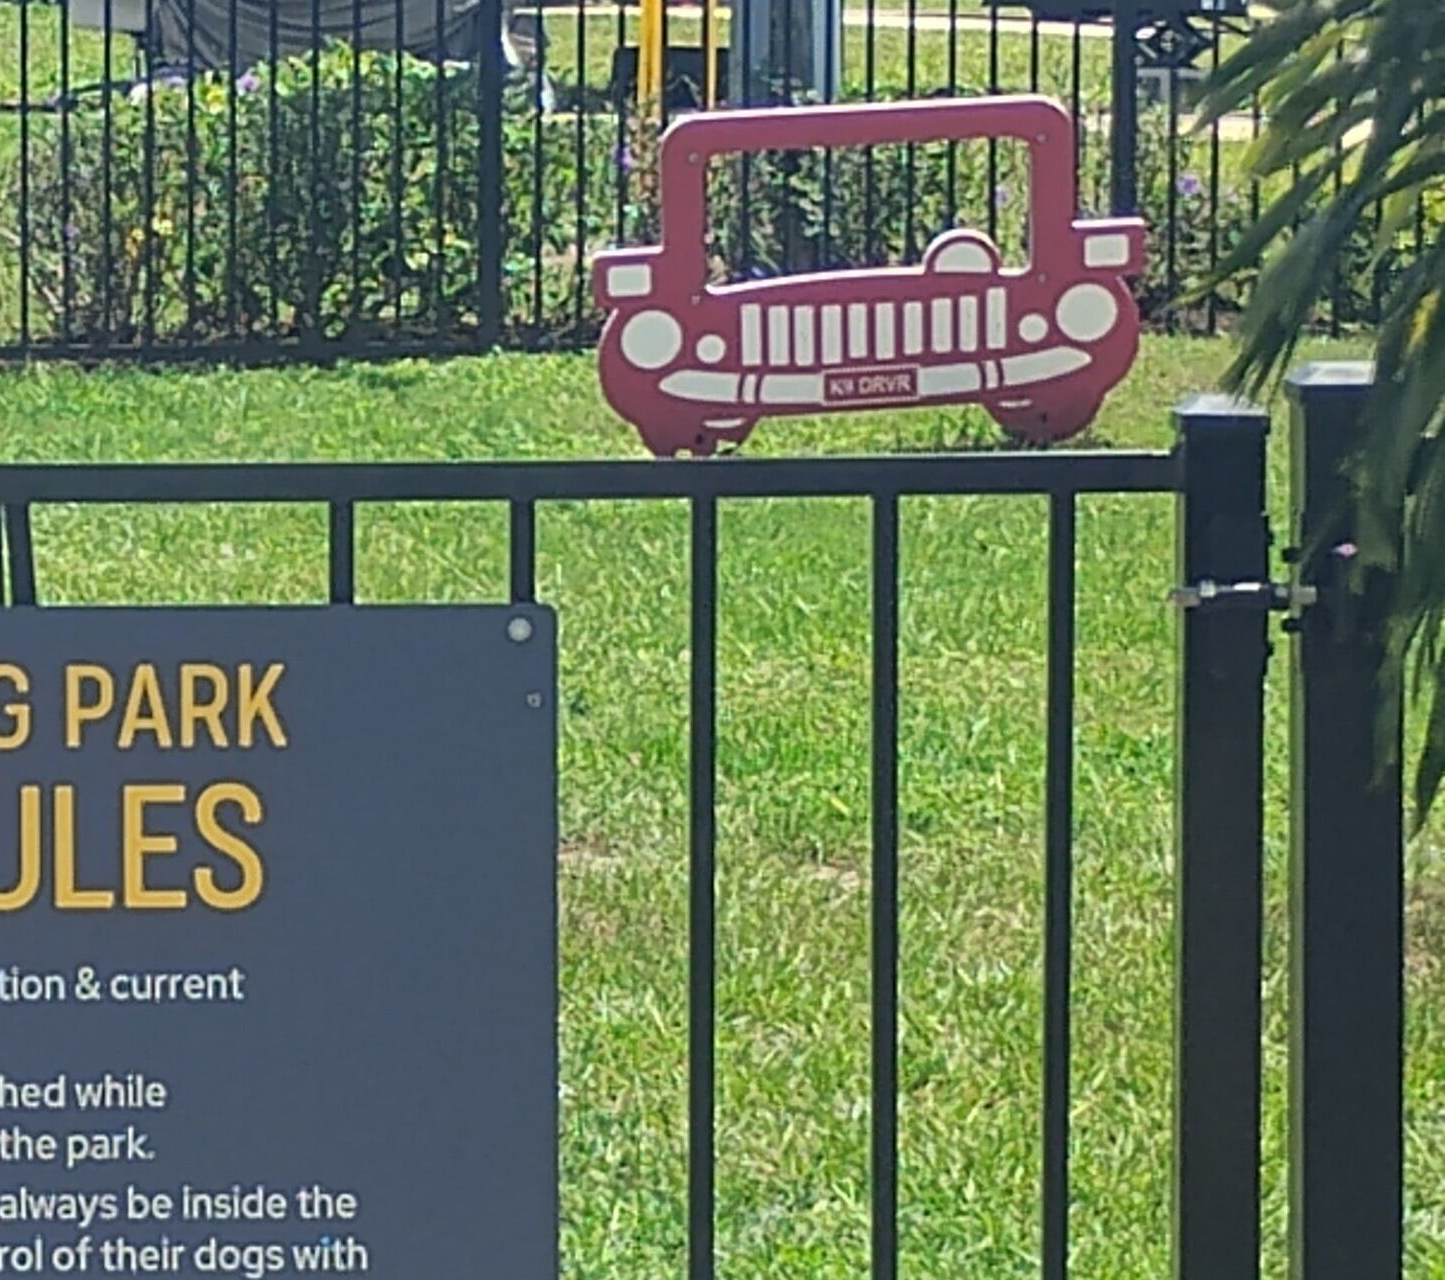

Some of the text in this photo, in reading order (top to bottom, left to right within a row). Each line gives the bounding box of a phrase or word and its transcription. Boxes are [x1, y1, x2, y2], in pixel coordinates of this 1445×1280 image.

[858, 374, 911, 395] DRVR
[66, 663, 287, 748] PARK
[74, 966, 101, 1001] &
[110, 968, 245, 1001] current
[74, 1074, 167, 1109] while
[67, 1125, 155, 1169] park.
[127, 1185, 174, 1220] be
[182, 1184, 288, 1220] inside
[295, 1184, 358, 1219] the
[51, 1235, 93, 1272] of
[99, 1235, 186, 1274] their
[193, 1237, 285, 1280] dogs
[291, 1236, 368, 1271] with
